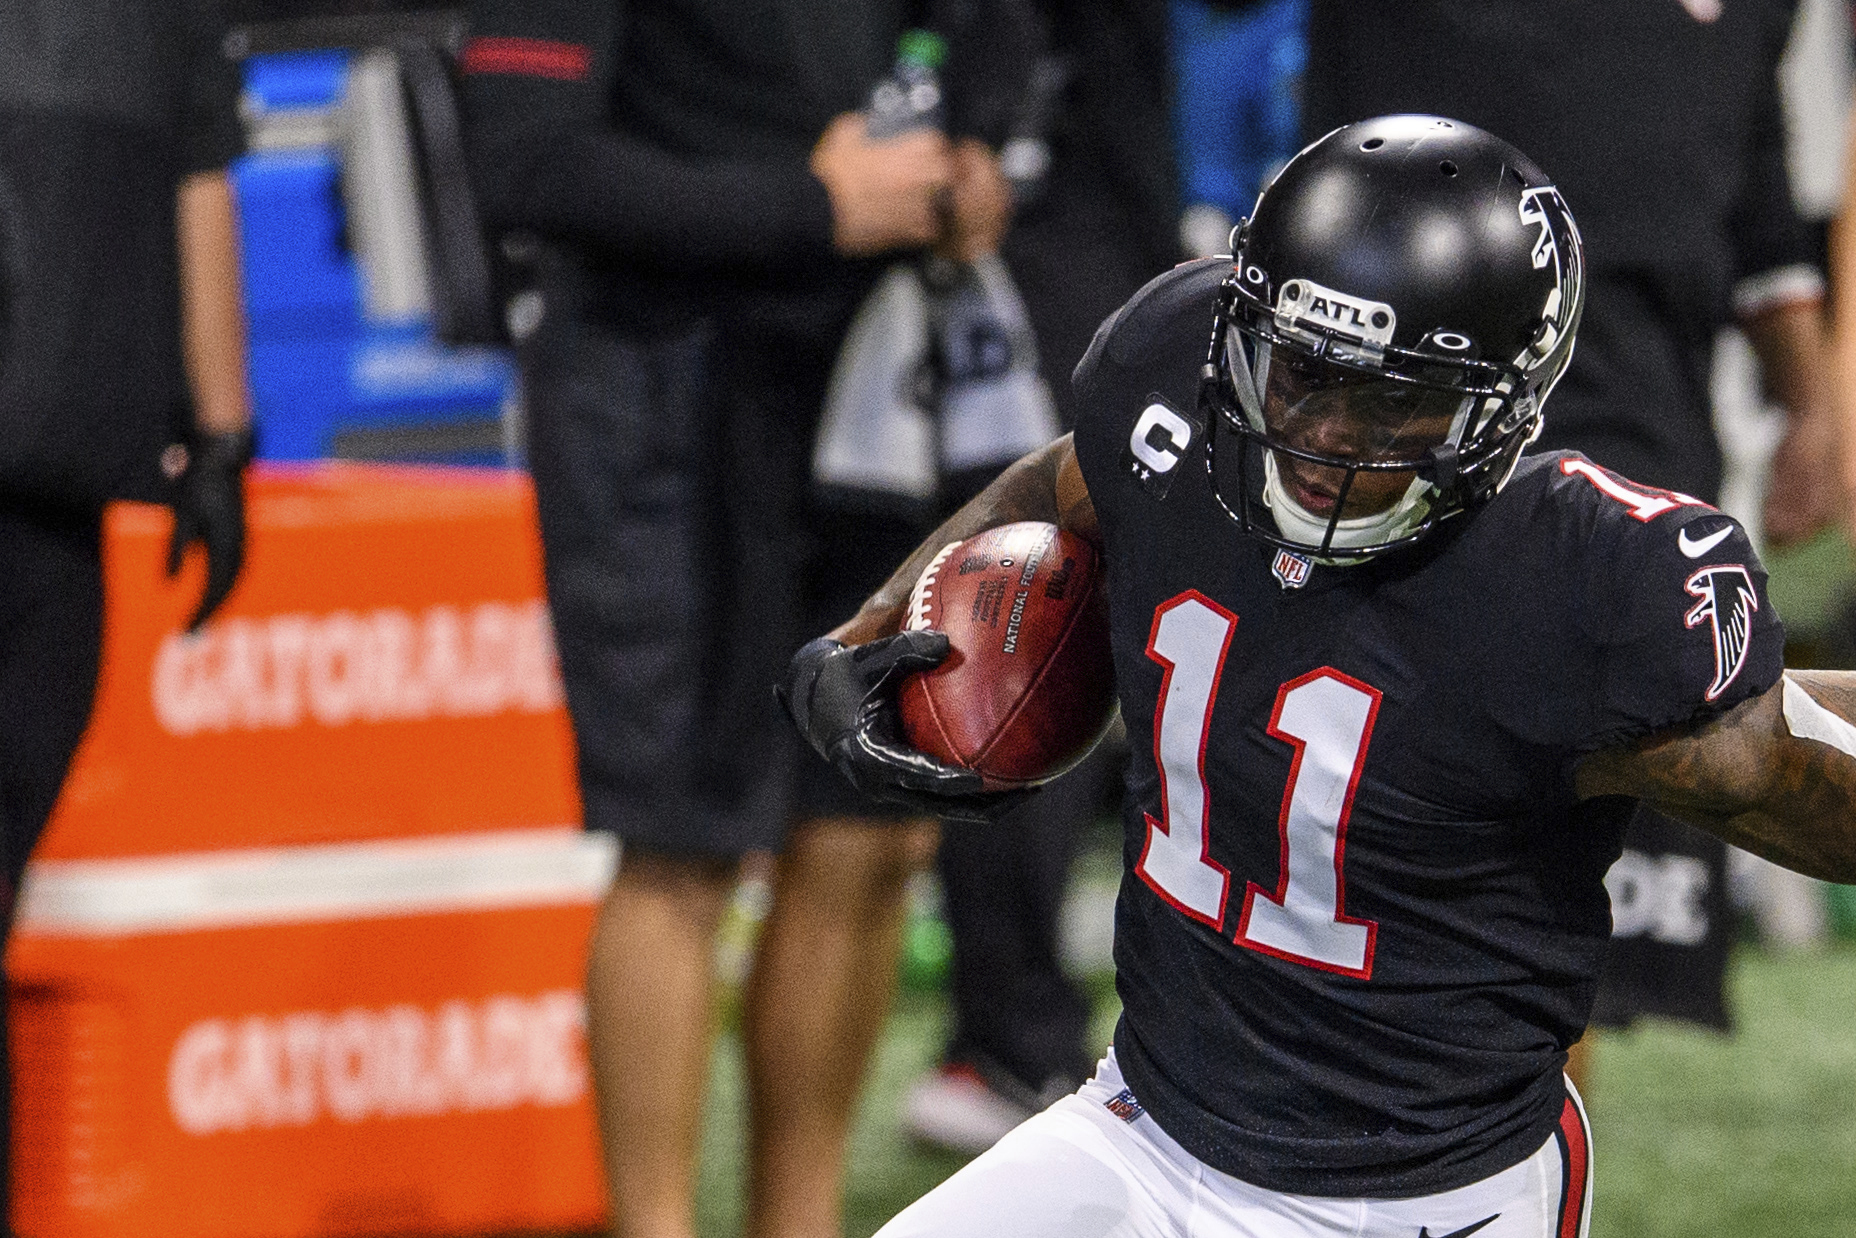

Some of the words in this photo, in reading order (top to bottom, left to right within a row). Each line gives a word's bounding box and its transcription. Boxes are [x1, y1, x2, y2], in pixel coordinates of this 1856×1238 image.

[1309, 295, 1366, 328] ATL
[1130, 403, 1191, 473] C
[1277, 552, 1304, 581] NFL
[1002, 588, 1028, 653] NATIONAL
[1134, 588, 1383, 981] 11
[171, 994, 586, 1132] GATORADE
